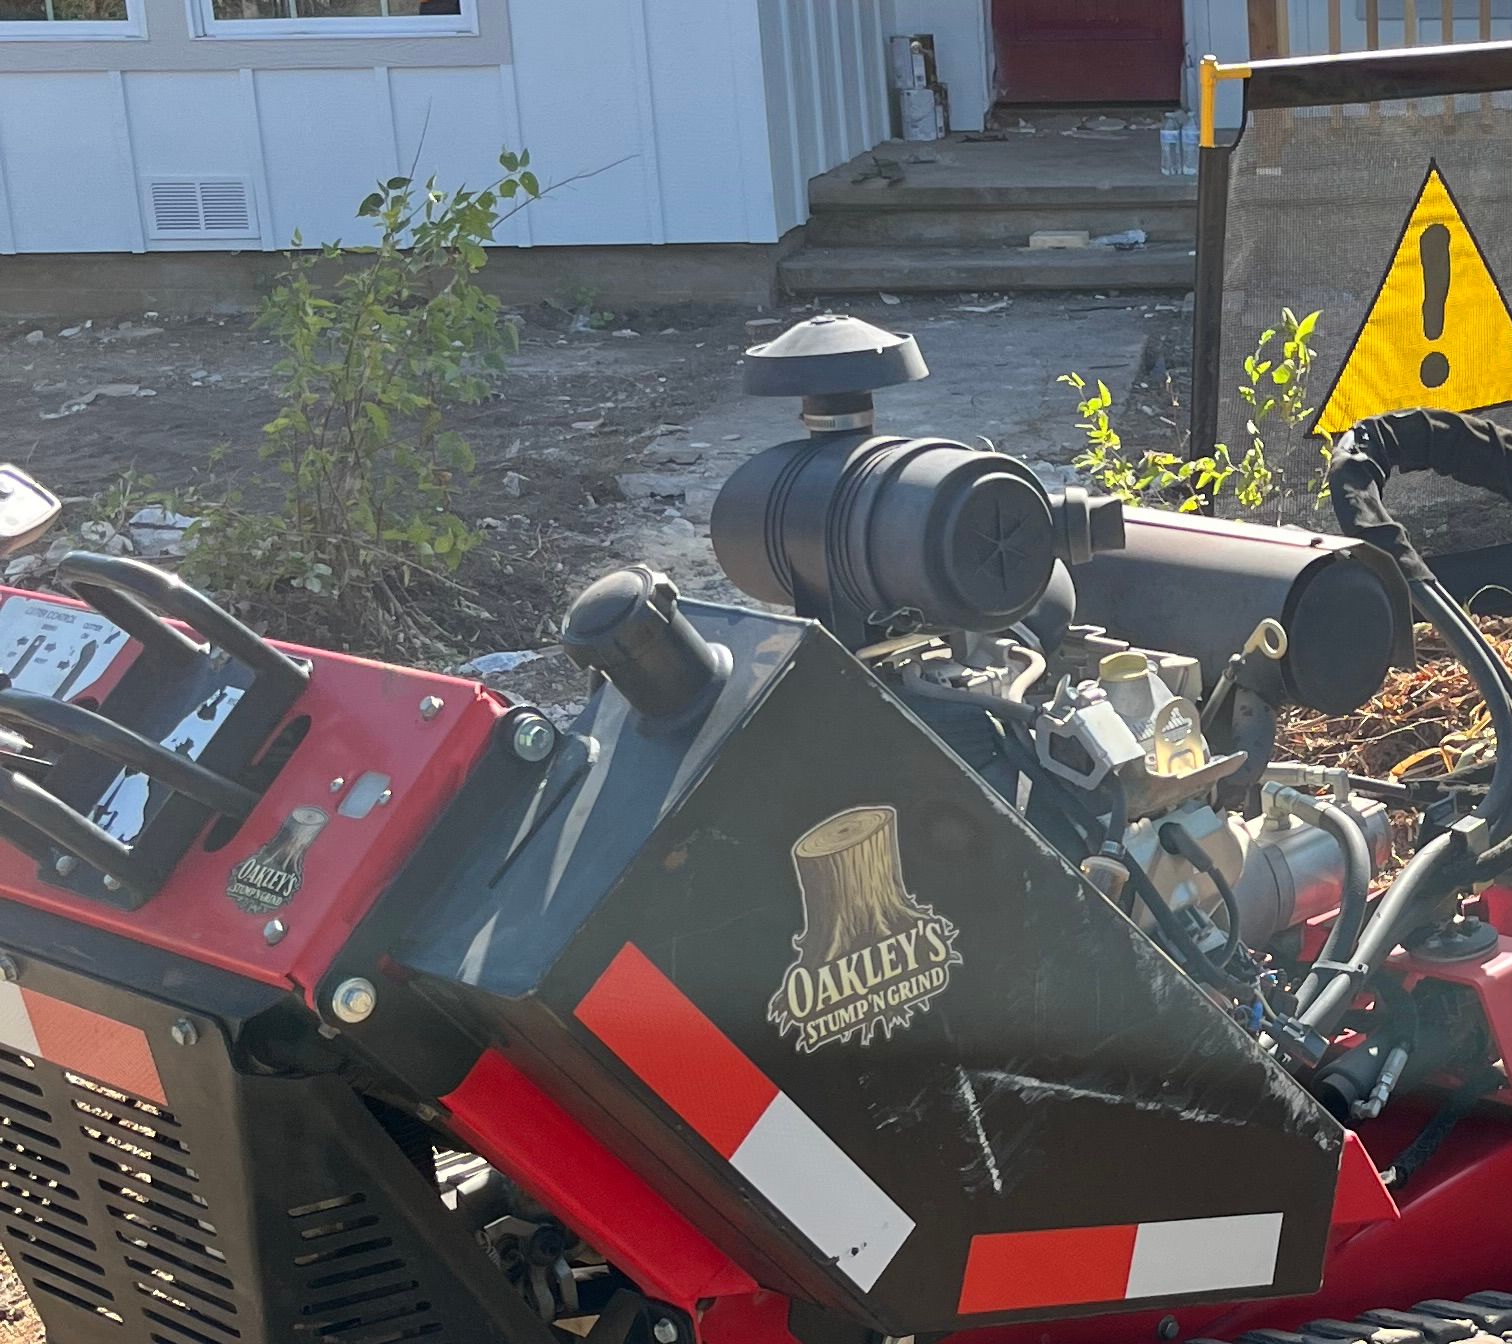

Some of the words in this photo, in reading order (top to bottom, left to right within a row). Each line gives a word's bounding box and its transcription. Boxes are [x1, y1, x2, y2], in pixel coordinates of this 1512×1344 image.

[237, 858, 298, 897] OAKLEY'S
[787, 919, 948, 1019] OAKLEY'S
[889, 965, 946, 1007] GRIND
